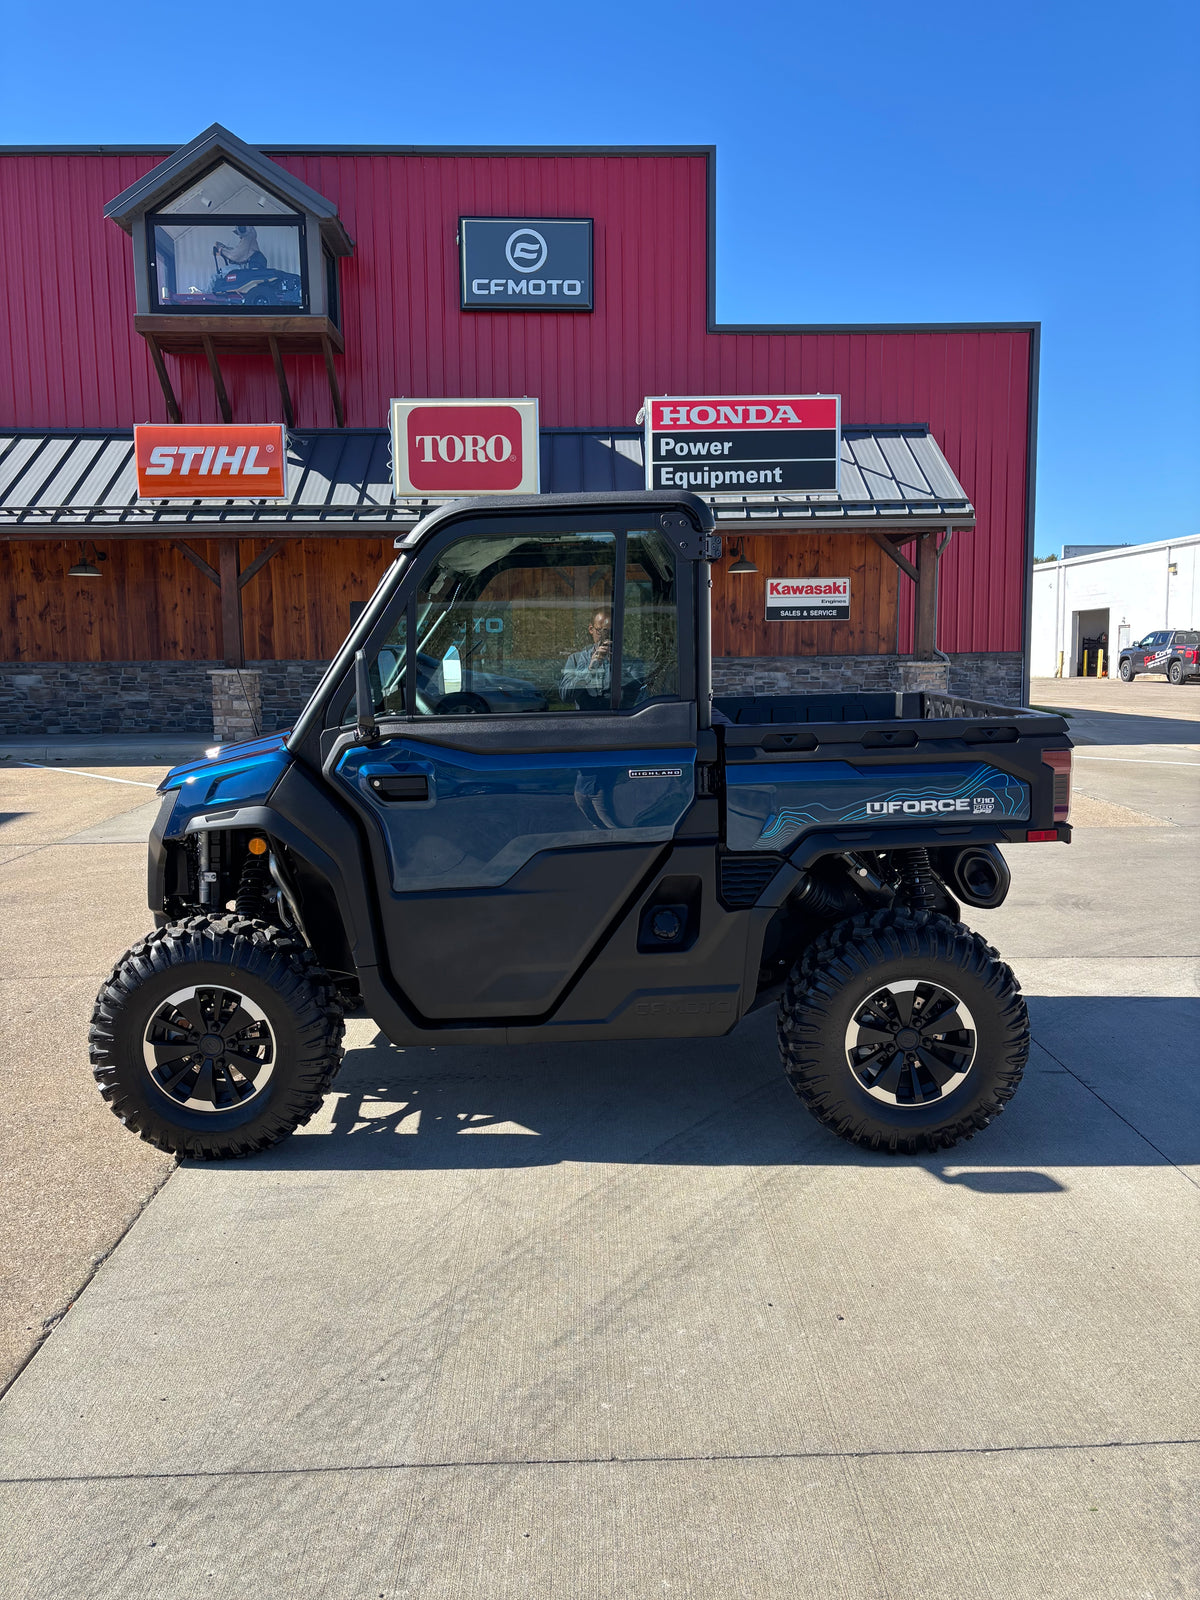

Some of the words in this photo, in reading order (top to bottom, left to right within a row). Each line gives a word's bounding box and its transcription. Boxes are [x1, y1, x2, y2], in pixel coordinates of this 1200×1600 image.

[472, 279, 582, 296] CFMOTO
[660, 405, 802, 425] HONDA
[415, 434, 512, 463] TORO
[660, 438, 733, 456] Power
[145, 446, 270, 475] STIHL
[660, 467, 783, 488] Equipment
[769, 582, 847, 595] Kawasaki
[866, 798, 970, 814] UFORCE
